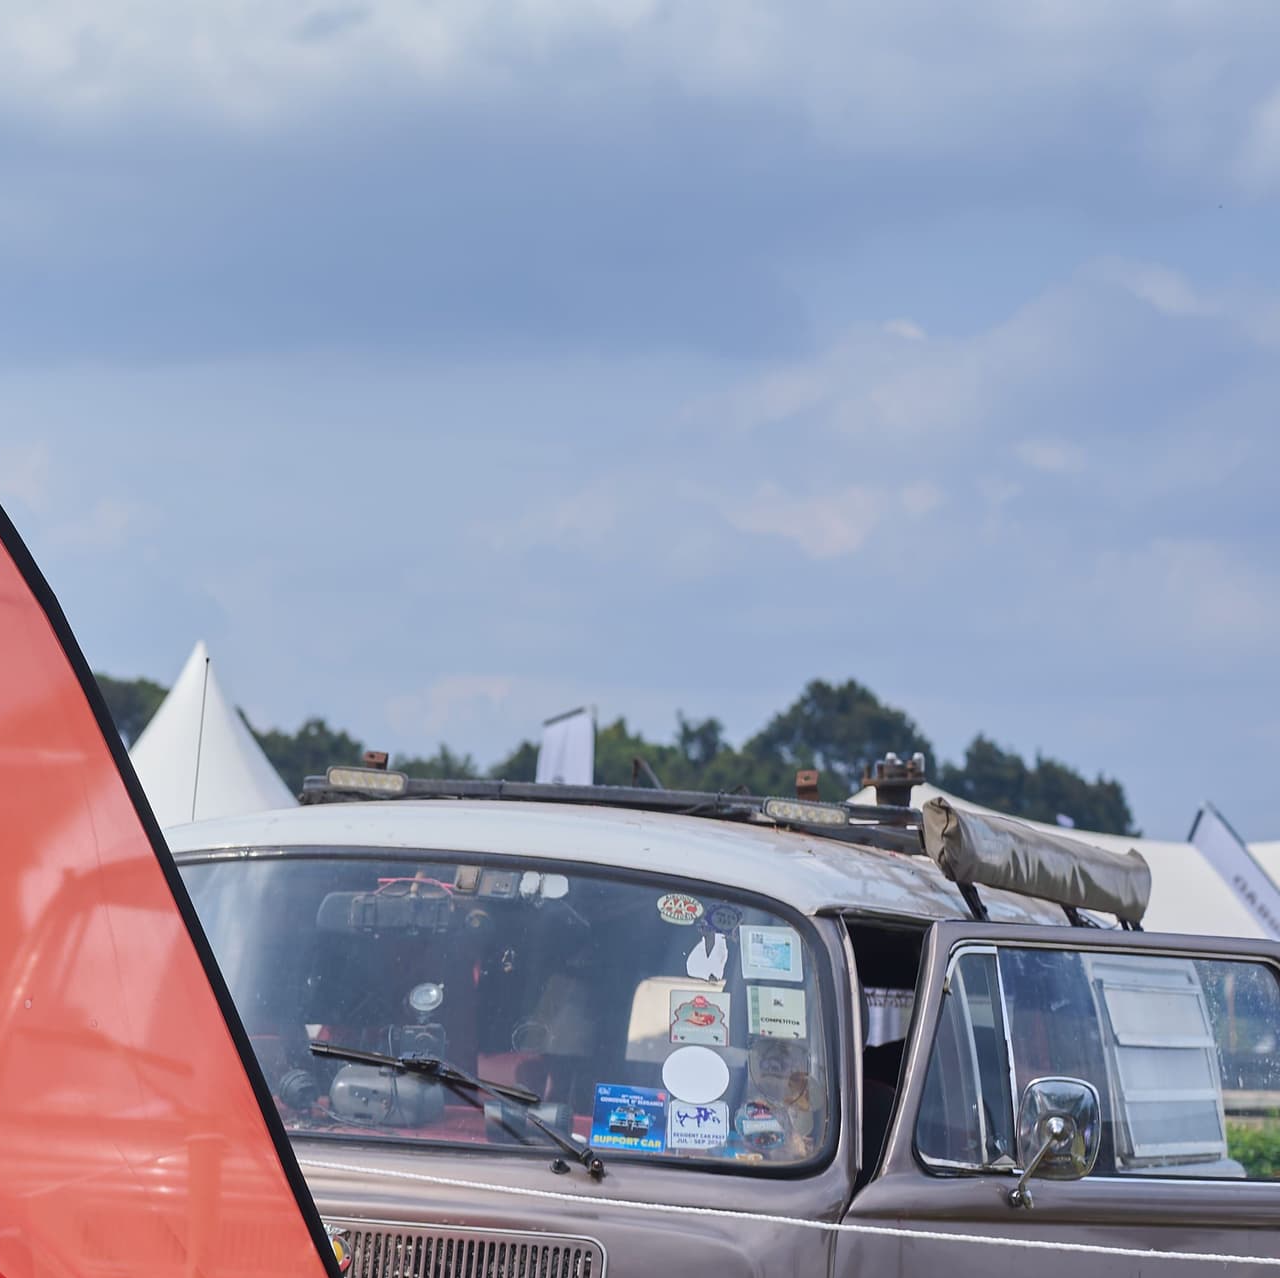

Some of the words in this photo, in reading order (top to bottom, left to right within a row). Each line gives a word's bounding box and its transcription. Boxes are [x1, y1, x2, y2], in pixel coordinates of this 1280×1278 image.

[664, 897, 698, 916] AAC
[760, 1016, 801, 1027] COMPETITOR
[593, 1134, 640, 1147] SUPPORT
[640, 1138, 662, 1148] CAR
